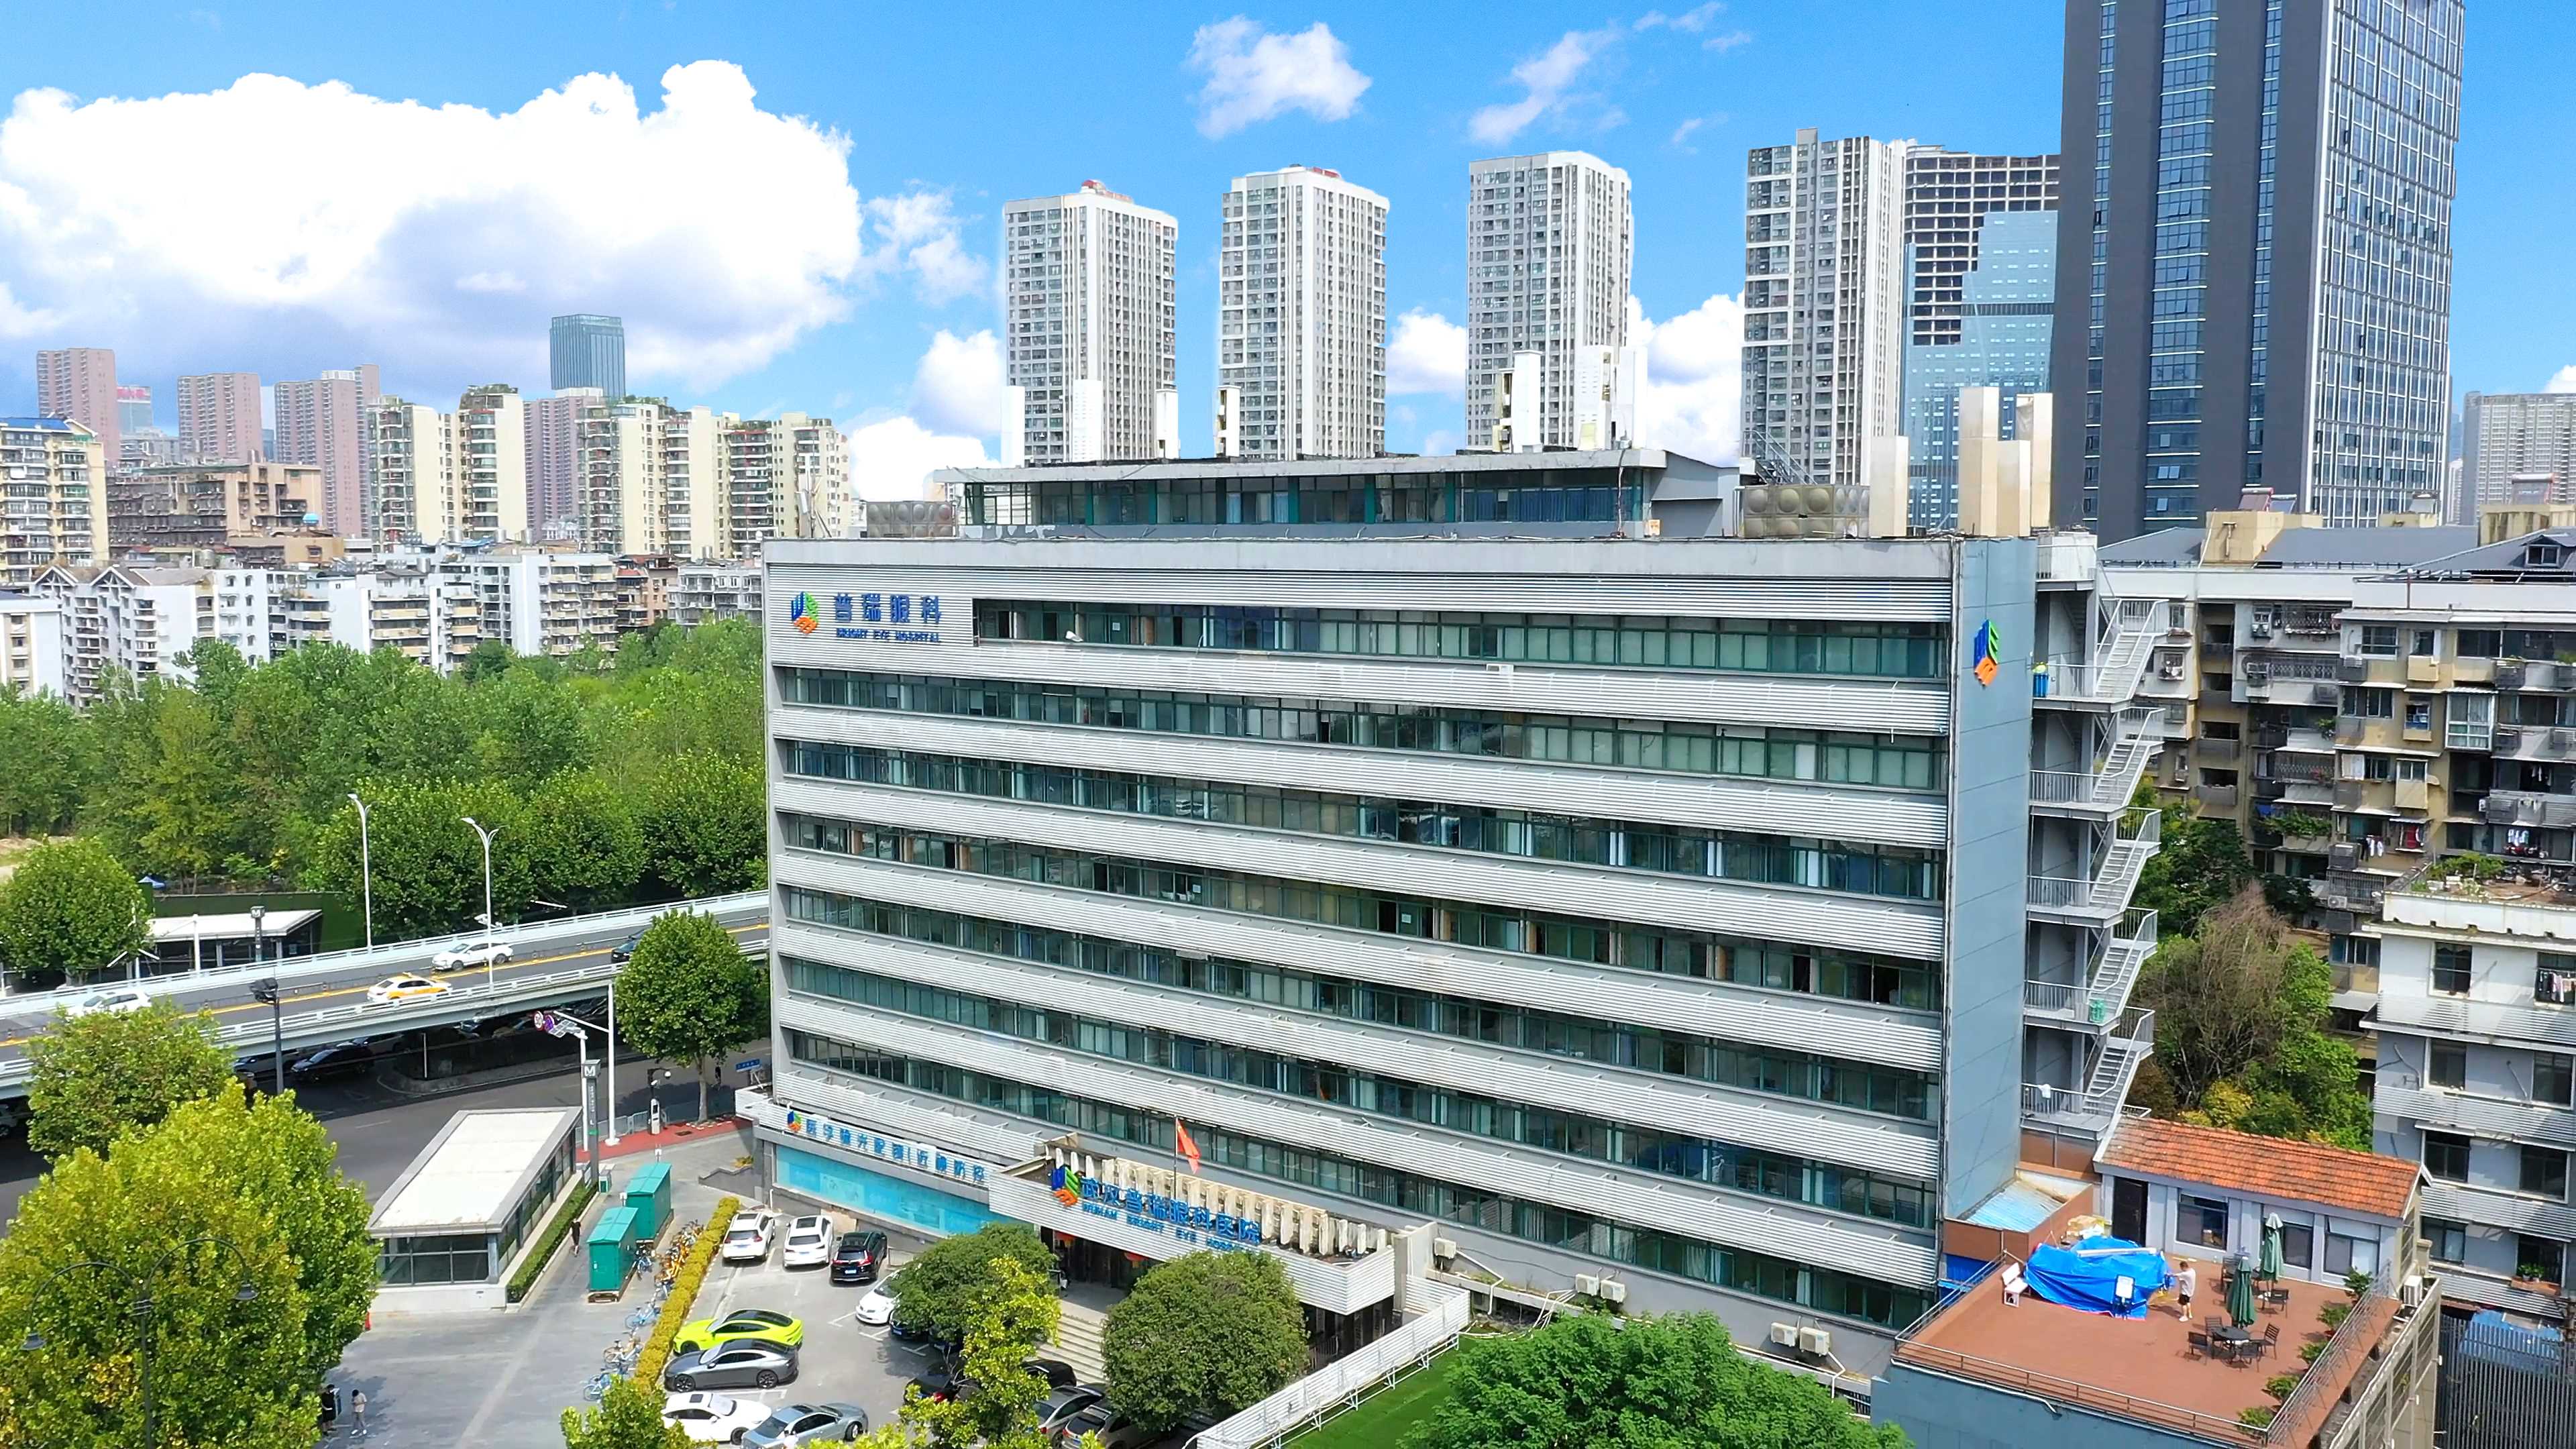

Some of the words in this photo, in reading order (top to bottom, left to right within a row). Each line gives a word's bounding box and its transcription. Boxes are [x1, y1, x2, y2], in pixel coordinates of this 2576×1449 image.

[834, 592, 941, 624] 普瑞眼科
[837, 628, 867, 639] BRIGHT
[874, 629, 890, 640] EYE
[1081, 1177, 1262, 1245] 武汉普瑞眼科医院
[1126, 1214, 1165, 1234] BRIGHT
[1176, 1227, 1197, 1242] EYE
